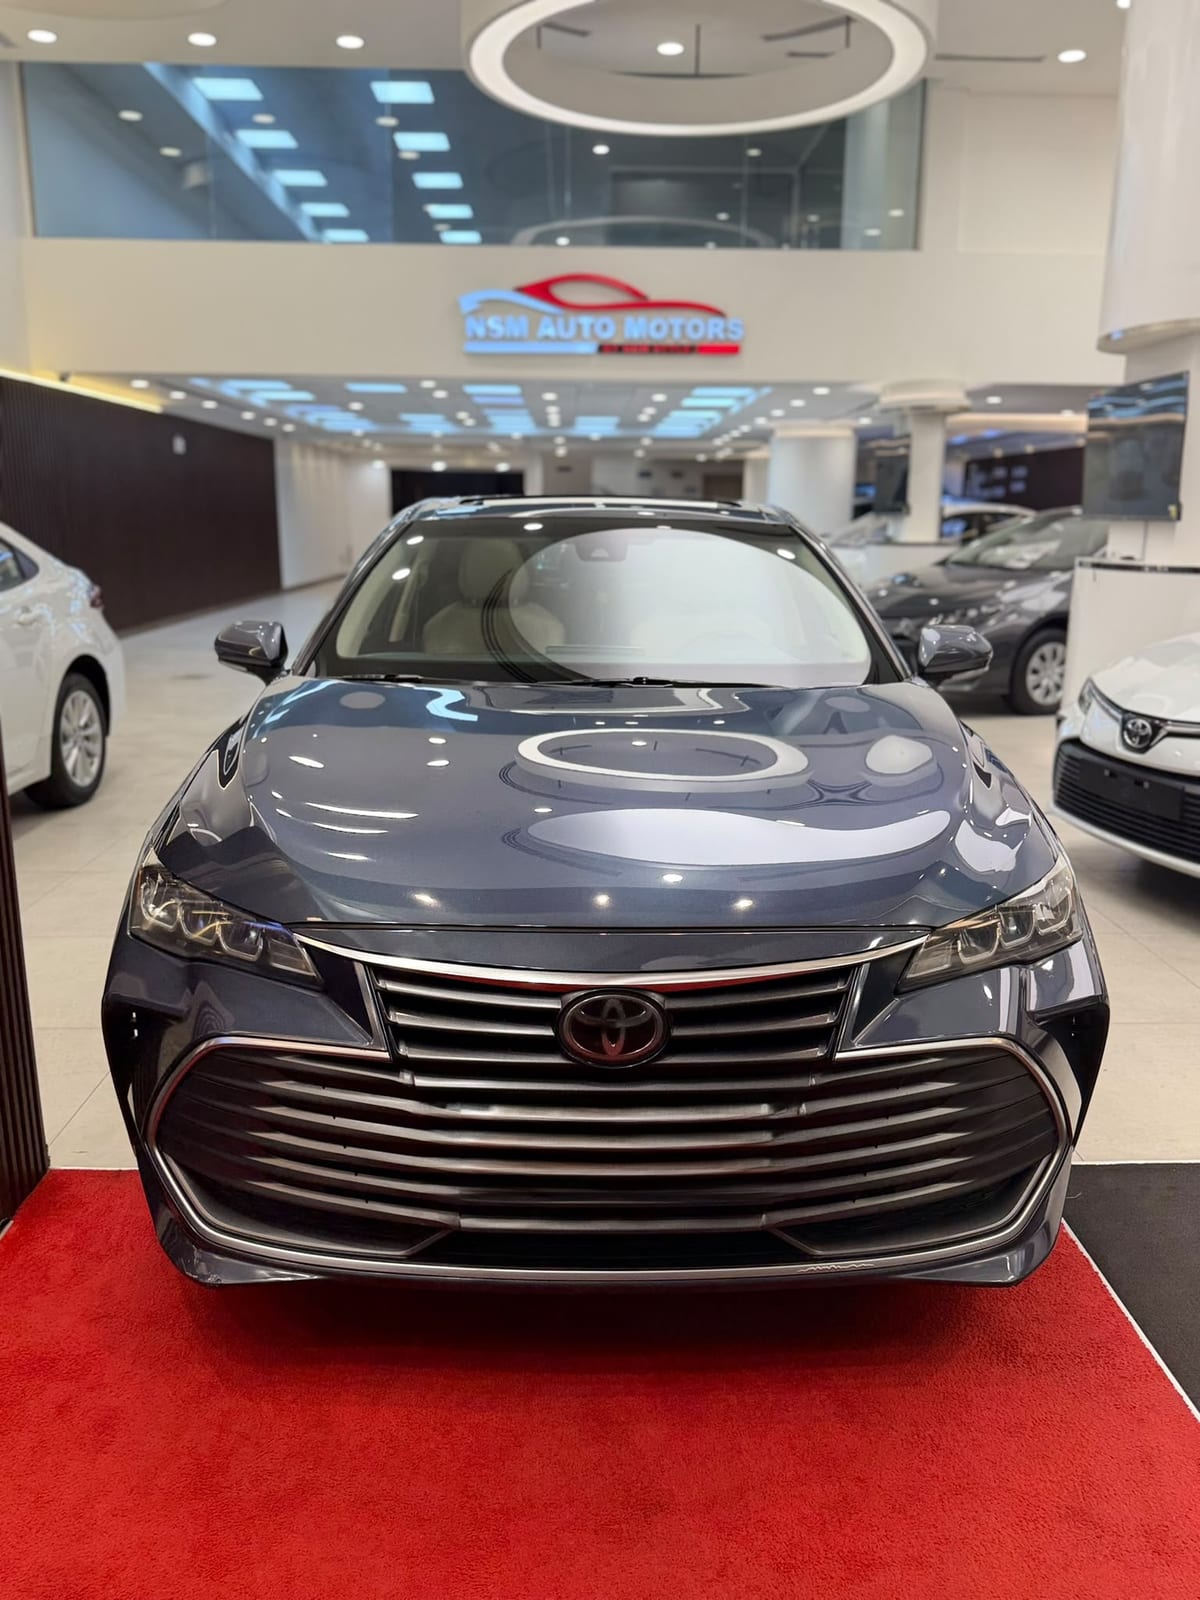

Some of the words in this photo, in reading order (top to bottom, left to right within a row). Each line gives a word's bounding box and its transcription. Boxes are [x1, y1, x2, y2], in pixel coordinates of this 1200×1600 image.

[465, 315, 530, 340] NSM
[537, 315, 617, 340] AUTO
[624, 316, 745, 341] MOTORS
